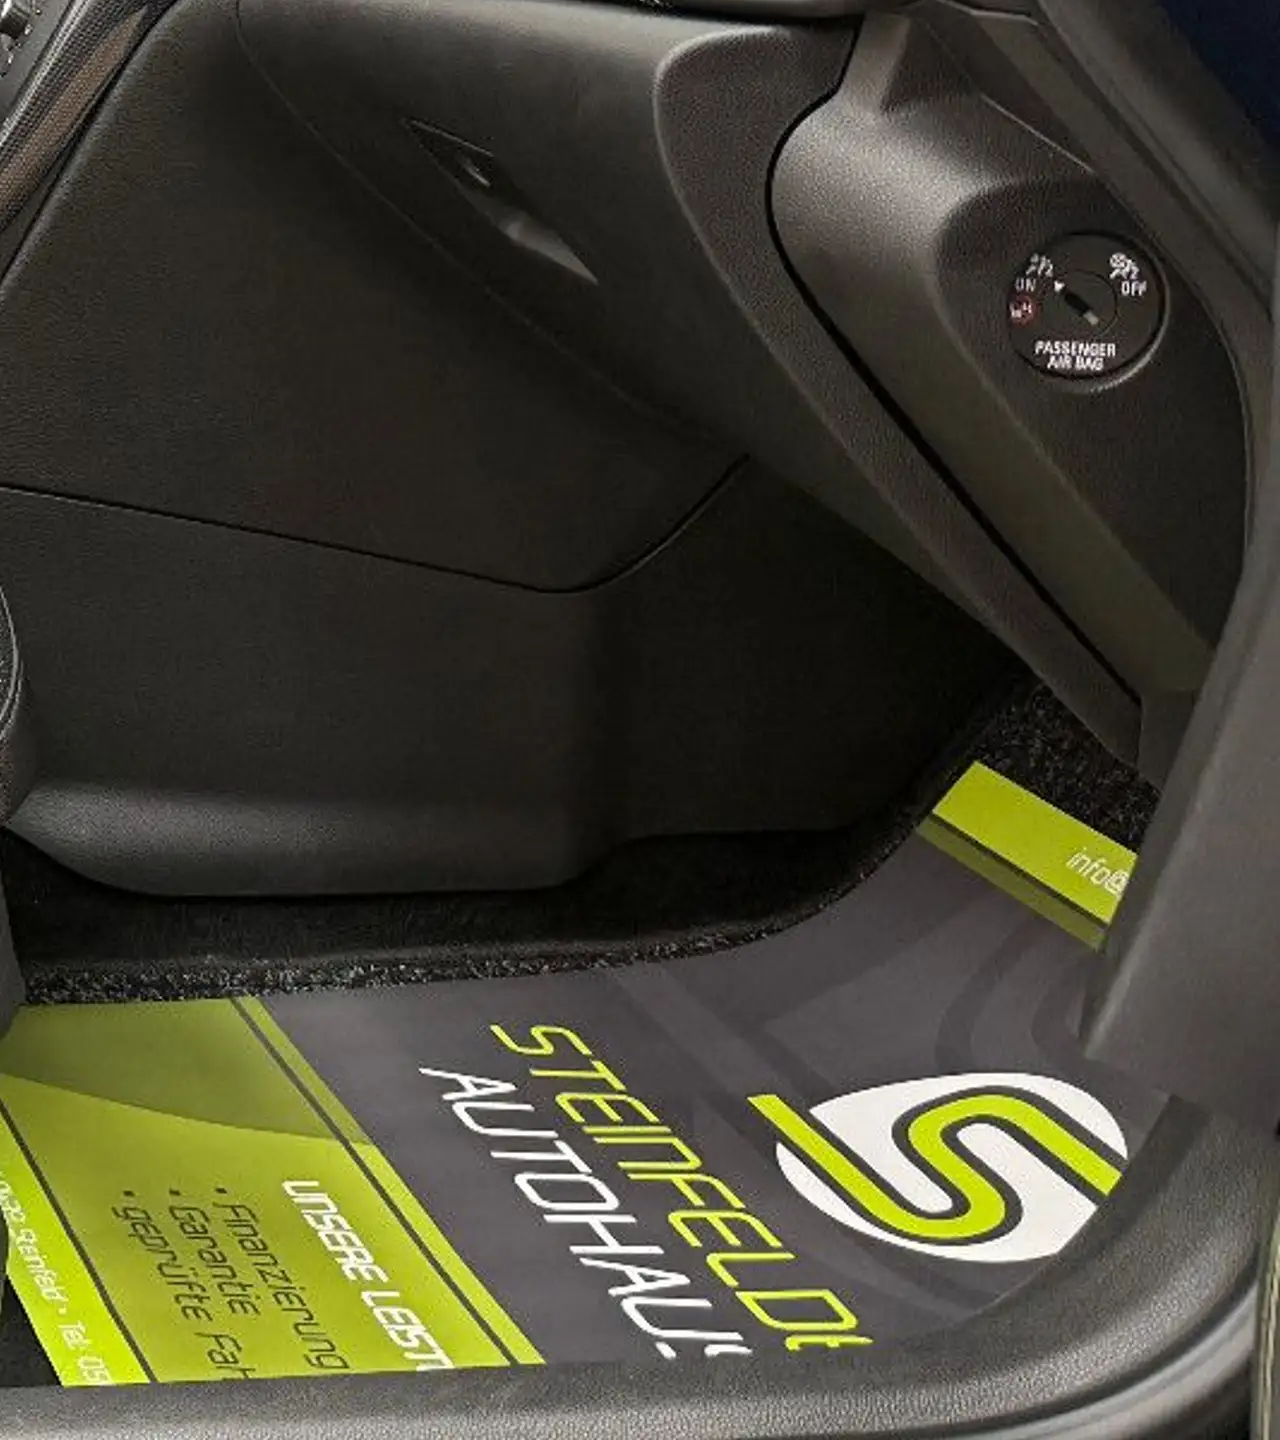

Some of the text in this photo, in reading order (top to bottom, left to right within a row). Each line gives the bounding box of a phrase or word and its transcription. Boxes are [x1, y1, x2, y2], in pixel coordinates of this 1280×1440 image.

[1121, 281, 1148, 297] OFF
[1034, 339, 1117, 358] PASSENGER
[1046, 355, 1104, 372] AIR BAG
[112, 1205, 214, 1323] geprüfte
[169, 1205, 261, 1317] Garantie
[281, 1180, 389, 1283] UNSERE
[211, 1201, 350, 1371] Finanzierung
